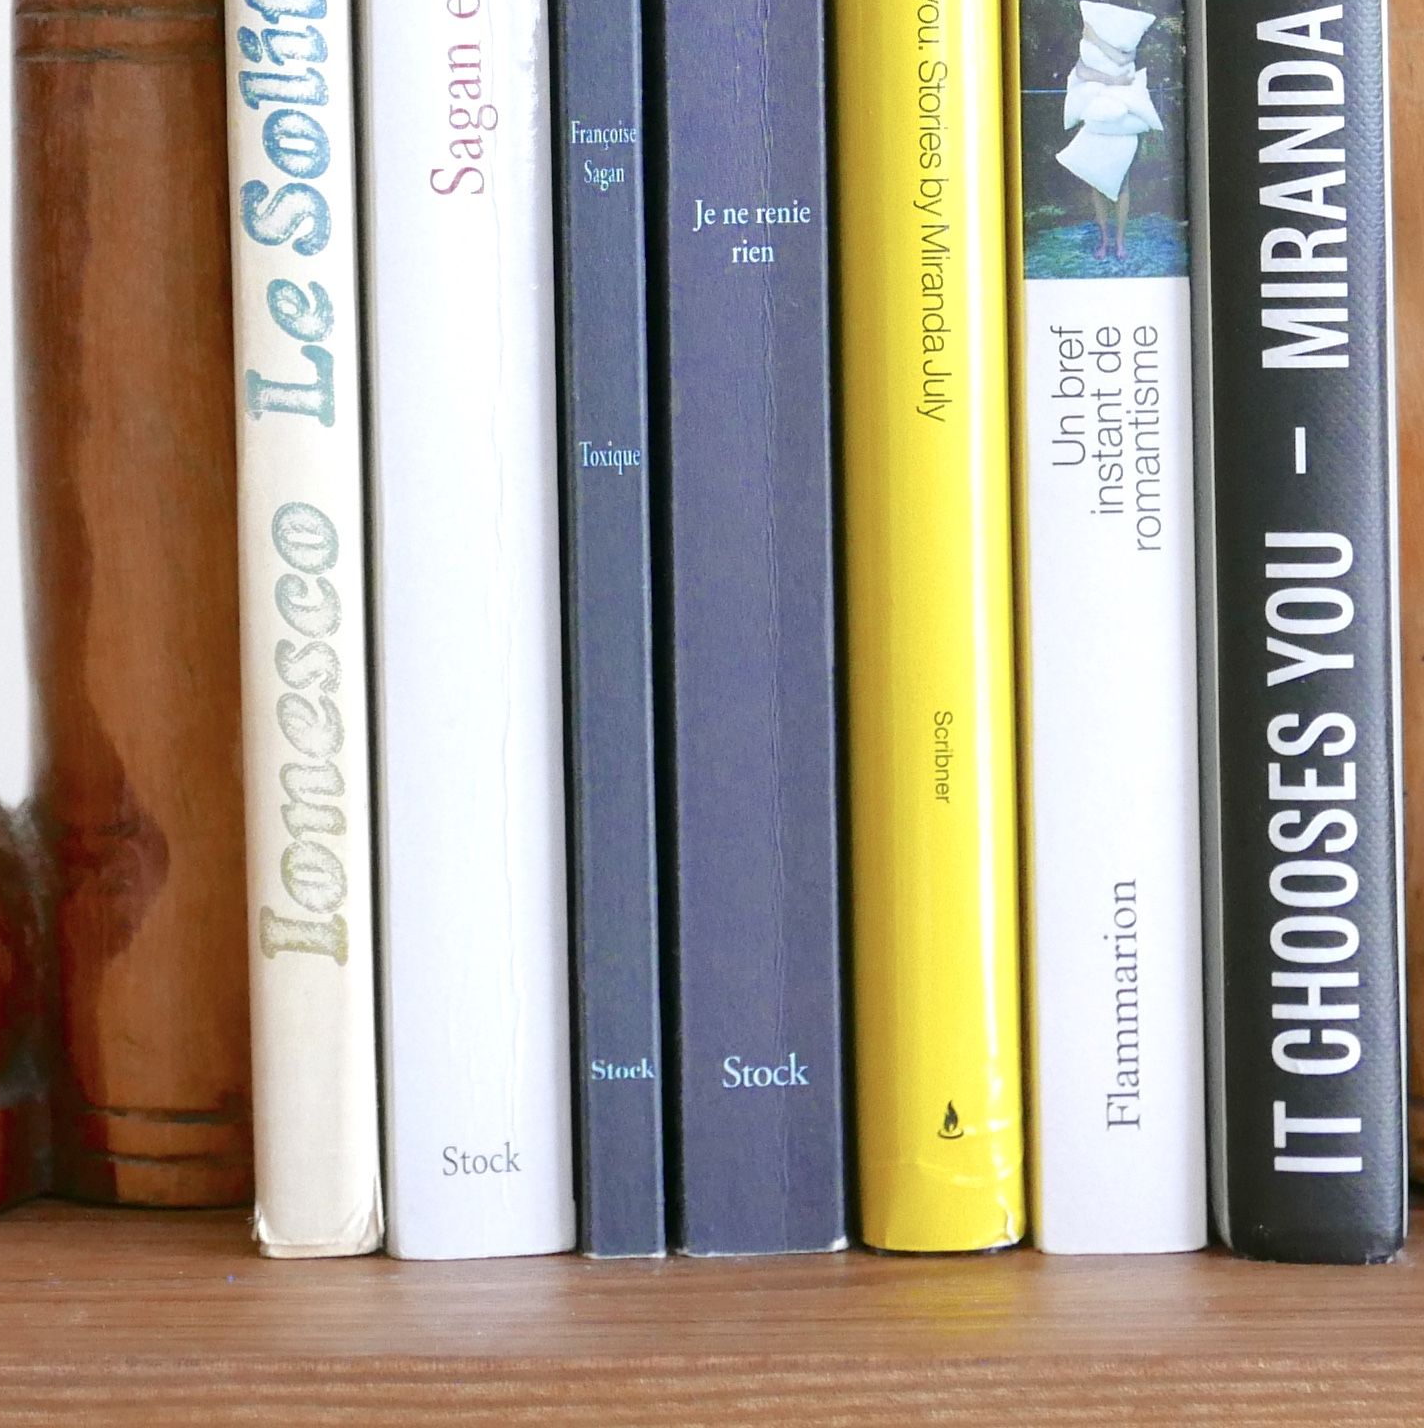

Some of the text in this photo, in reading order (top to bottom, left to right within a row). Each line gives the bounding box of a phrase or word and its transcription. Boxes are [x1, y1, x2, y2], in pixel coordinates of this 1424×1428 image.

[430, 42, 498, 196] Sagan
[570, 120, 637, 151] Françoise
[917, 61, 948, 170] Stories
[583, 159, 625, 191] Sagan
[693, 200, 812, 232] Je ne renie
[913, 178, 950, 216] by
[1256, 4, 1350, 369] MIRANDA
[731, 241, 775, 264] rien
[918, 223, 952, 354] Miranda
[245, 278, 335, 427] Le
[916, 355, 953, 422] July
[1049, 325, 1086, 467] Un bref
[579, 441, 641, 474] Toxique
[1087, 324, 1125, 515] instant de
[1128, 324, 1163, 552] romantisme
[1264, 531, 1355, 687] YOU
[259, 501, 349, 967] Ionesco
[932, 710, 954, 804] Scribner
[1266, 711, 1362, 1076] CHOOSES
[1103, 878, 1141, 1131] Flammarion
[590, 1058, 655, 1081] Stock
[722, 1052, 810, 1089] Stock
[441, 1142, 522, 1176] Stock
[1273, 1100, 1363, 1172] IT
